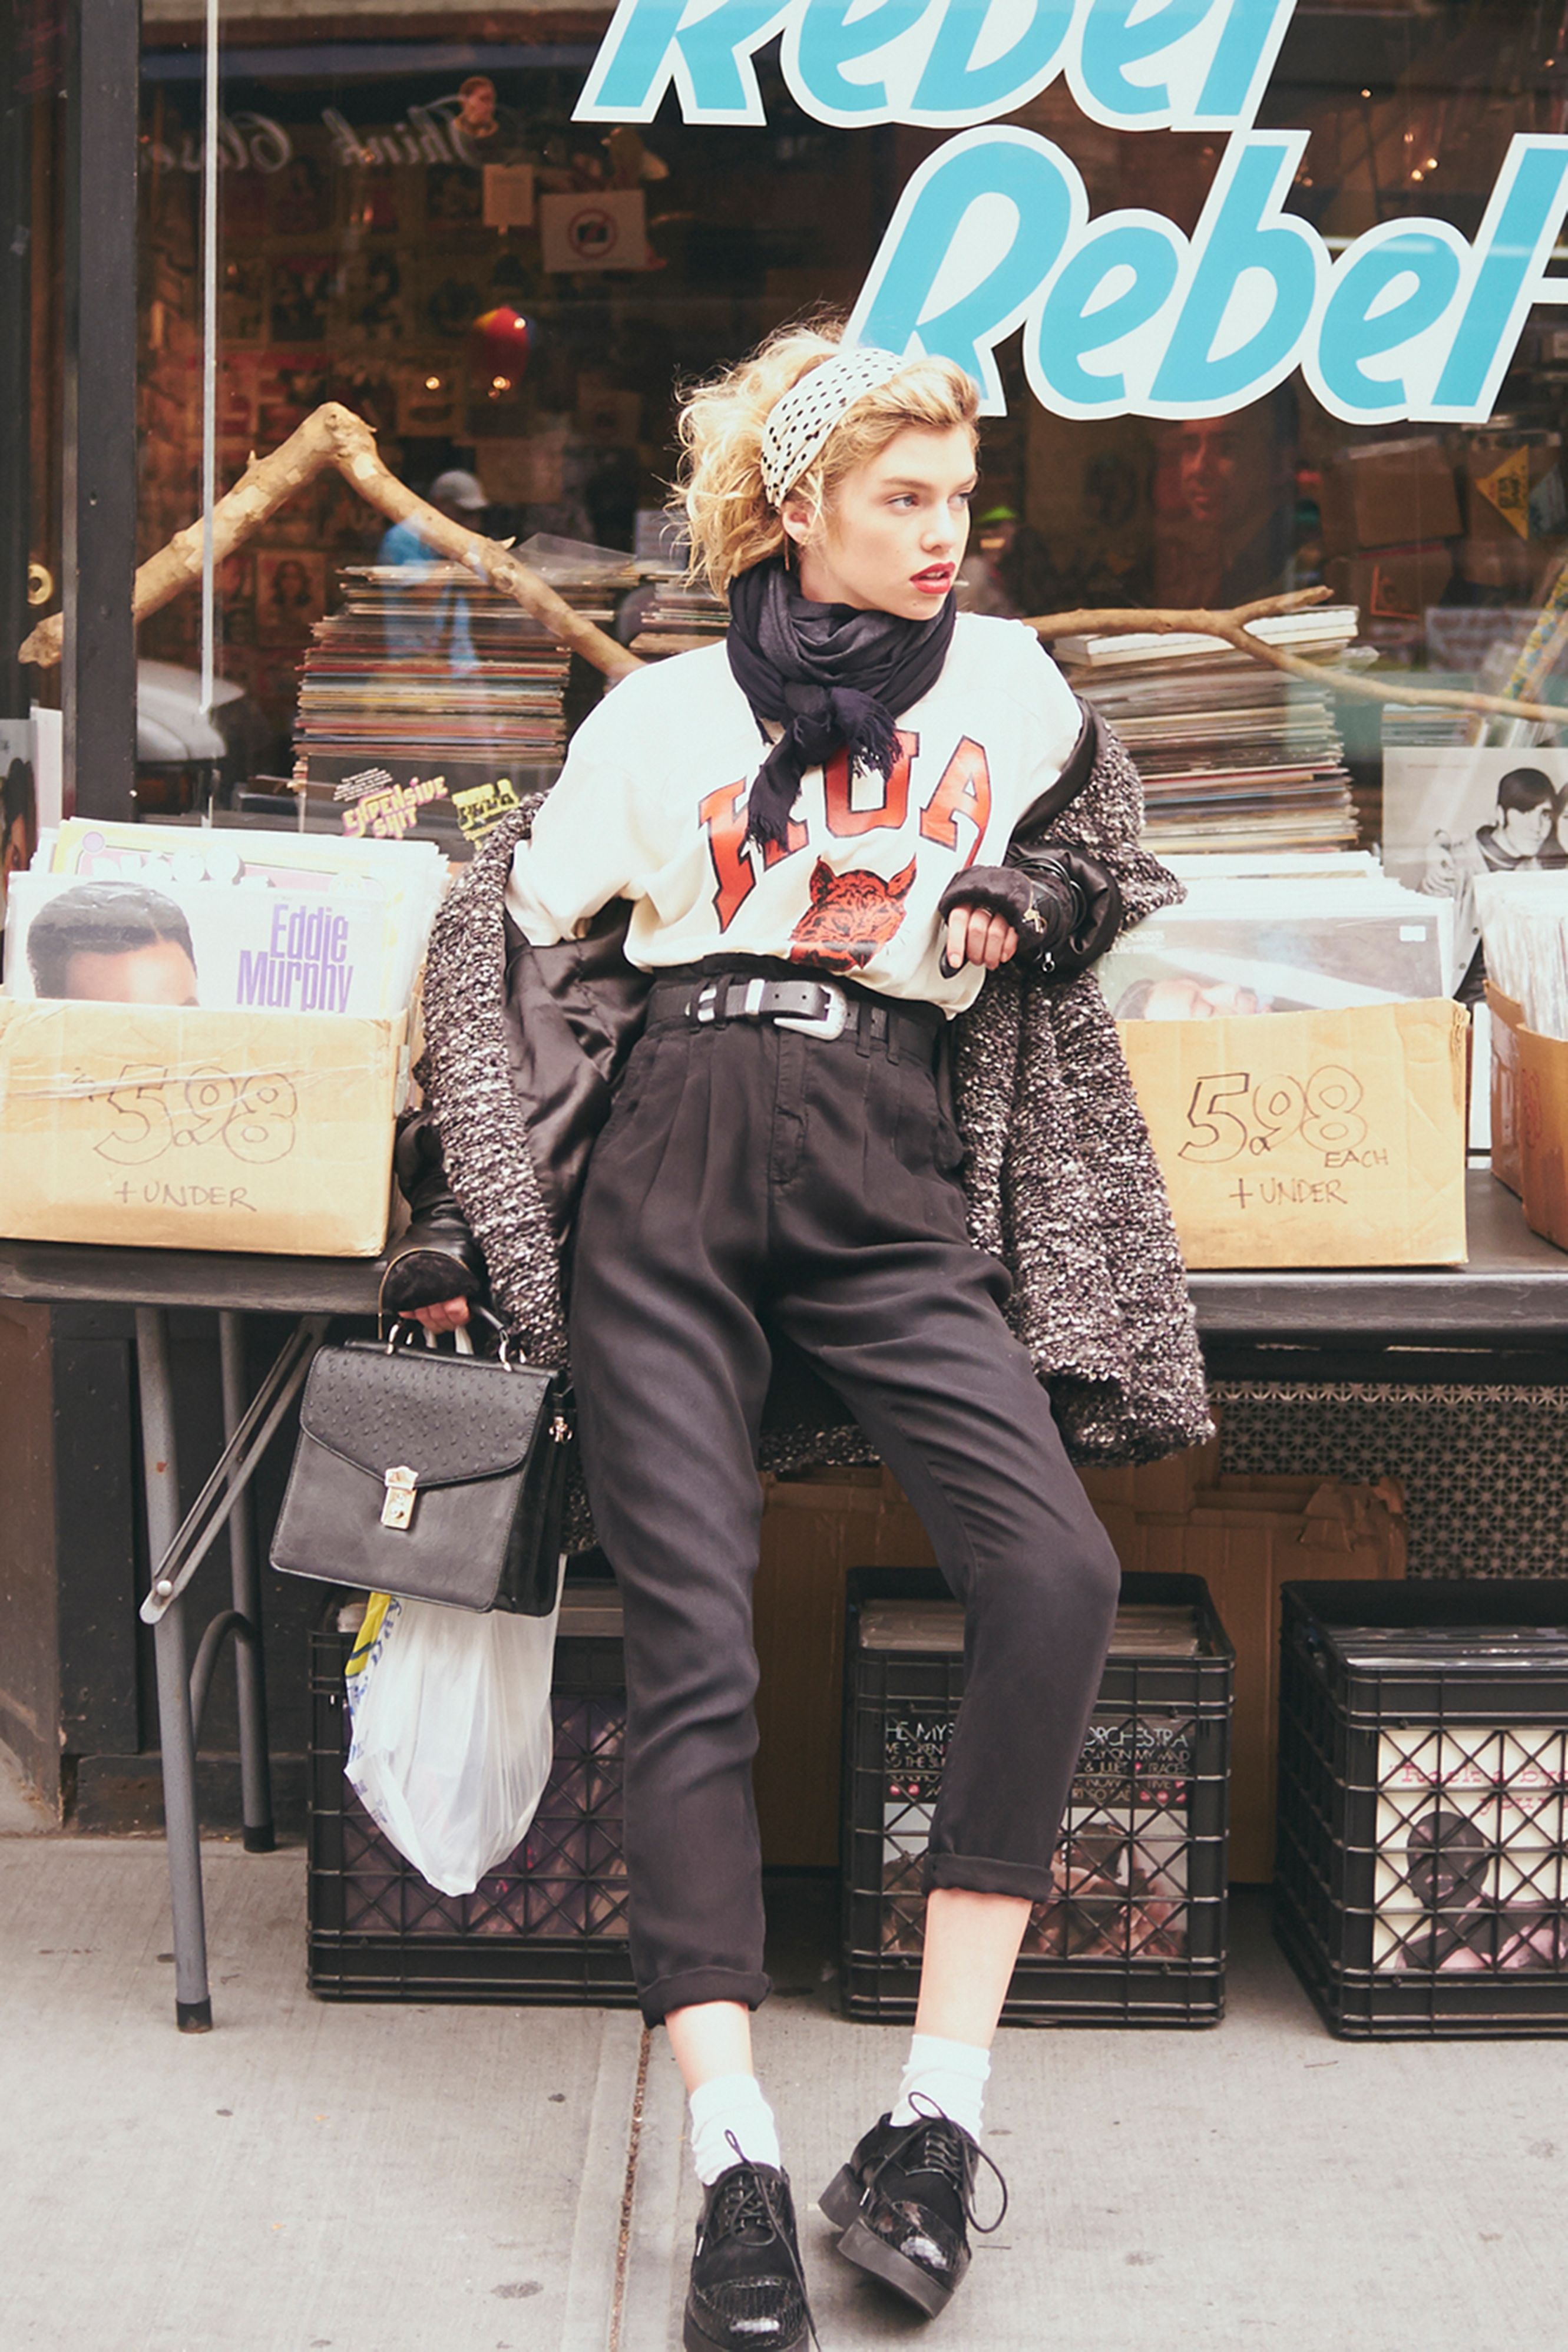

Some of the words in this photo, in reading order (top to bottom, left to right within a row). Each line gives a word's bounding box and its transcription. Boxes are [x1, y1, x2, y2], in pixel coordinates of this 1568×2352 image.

[841, 123, 1568, 425] Rebel
[270, 904, 349, 962] Eddie
[237, 950, 353, 1013] Murphy
[1177, 1064, 1369, 1164] 5.98
[1324, 1148, 1389, 1169] EACH
